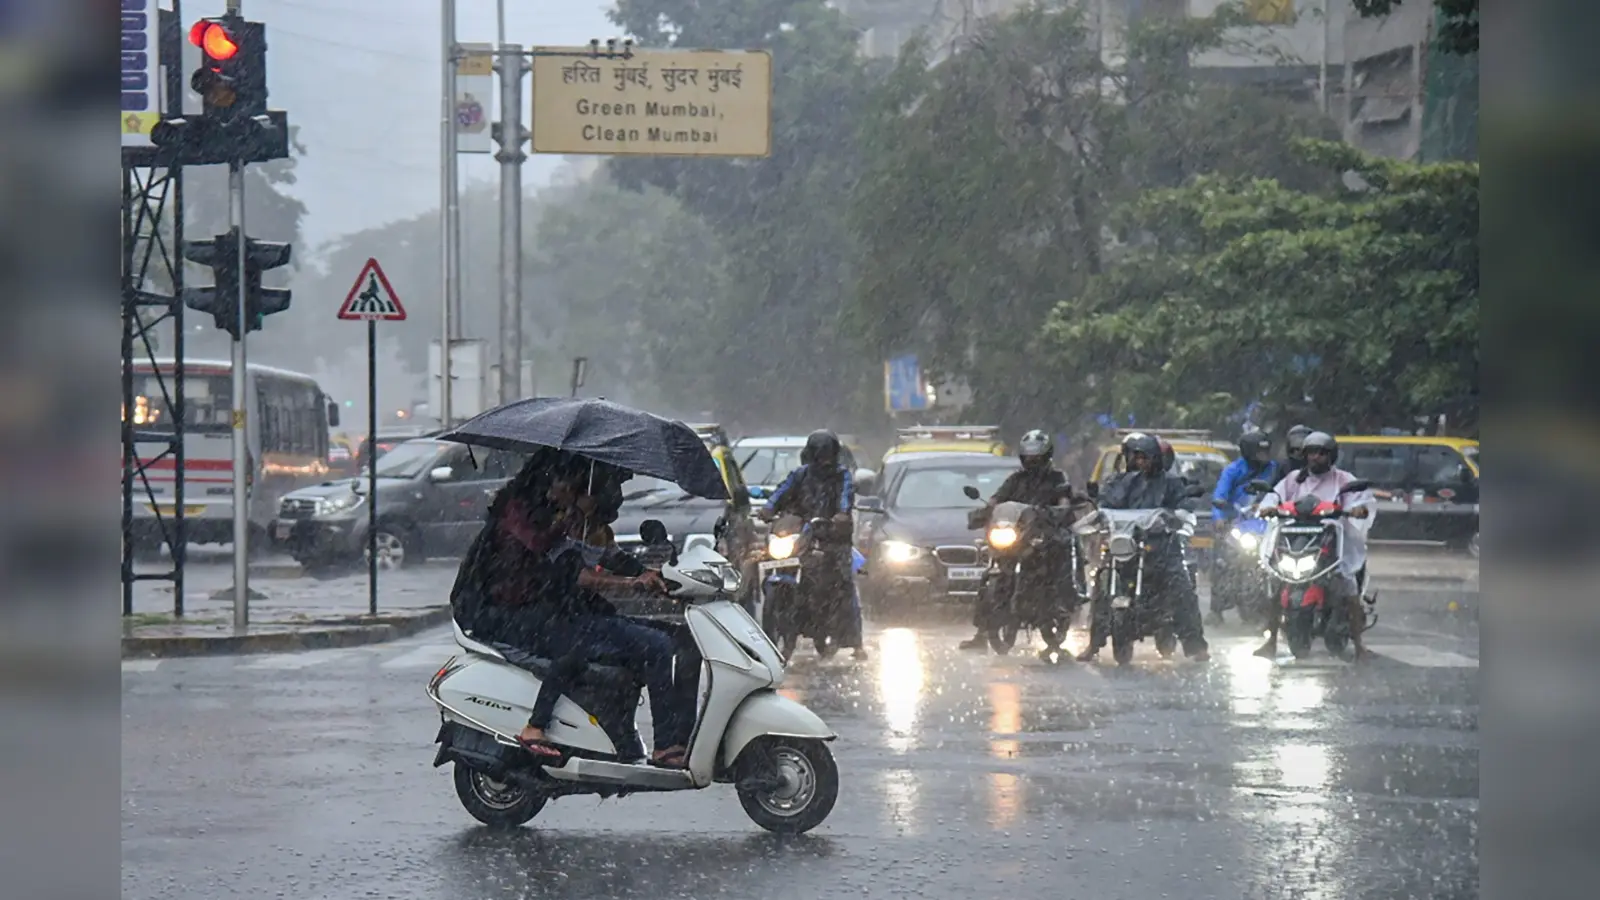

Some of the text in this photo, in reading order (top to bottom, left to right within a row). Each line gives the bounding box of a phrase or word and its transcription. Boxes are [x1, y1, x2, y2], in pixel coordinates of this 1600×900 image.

[562, 60, 601, 84] हरित
[661, 62, 699, 92] सुंदर
[707, 62, 744, 92] मुंबई
[576, 98, 724, 121] Green Mumbai,
[582, 124, 718, 143] Clean Mumbai
